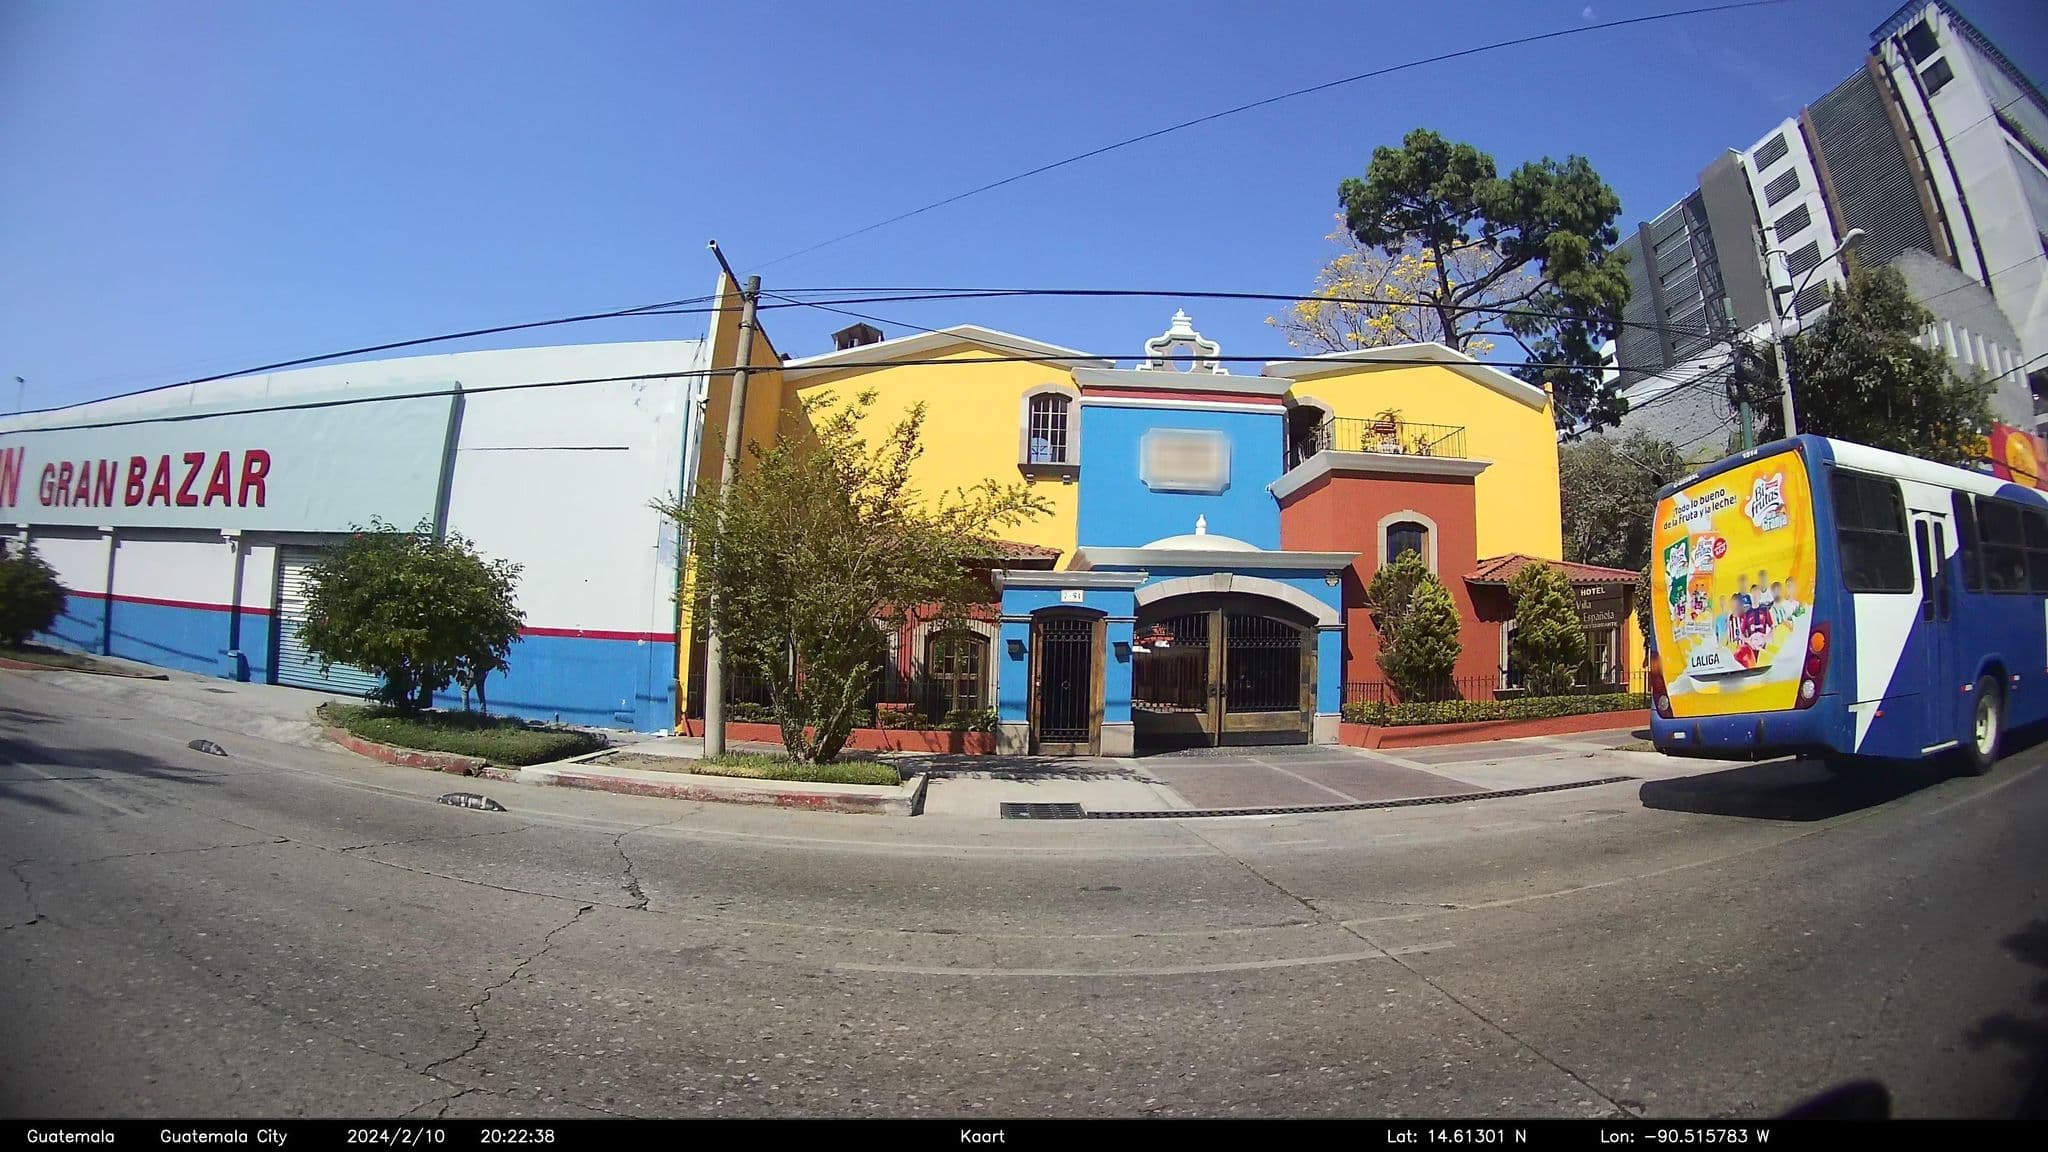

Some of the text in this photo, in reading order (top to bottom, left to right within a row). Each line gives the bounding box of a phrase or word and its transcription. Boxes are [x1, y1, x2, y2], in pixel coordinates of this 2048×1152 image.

[39, 459, 117, 507] GRAN
[124, 449, 271, 508] BAZAR
[1691, 499, 1699, 509] lo
[1700, 488, 1726, 505] bueno
[1700, 508, 1704, 518] y
[1580, 587, 1606, 596] HOTEL
[1583, 610, 1615, 623] Española
[1691, 653, 1720, 668] LALIGA
